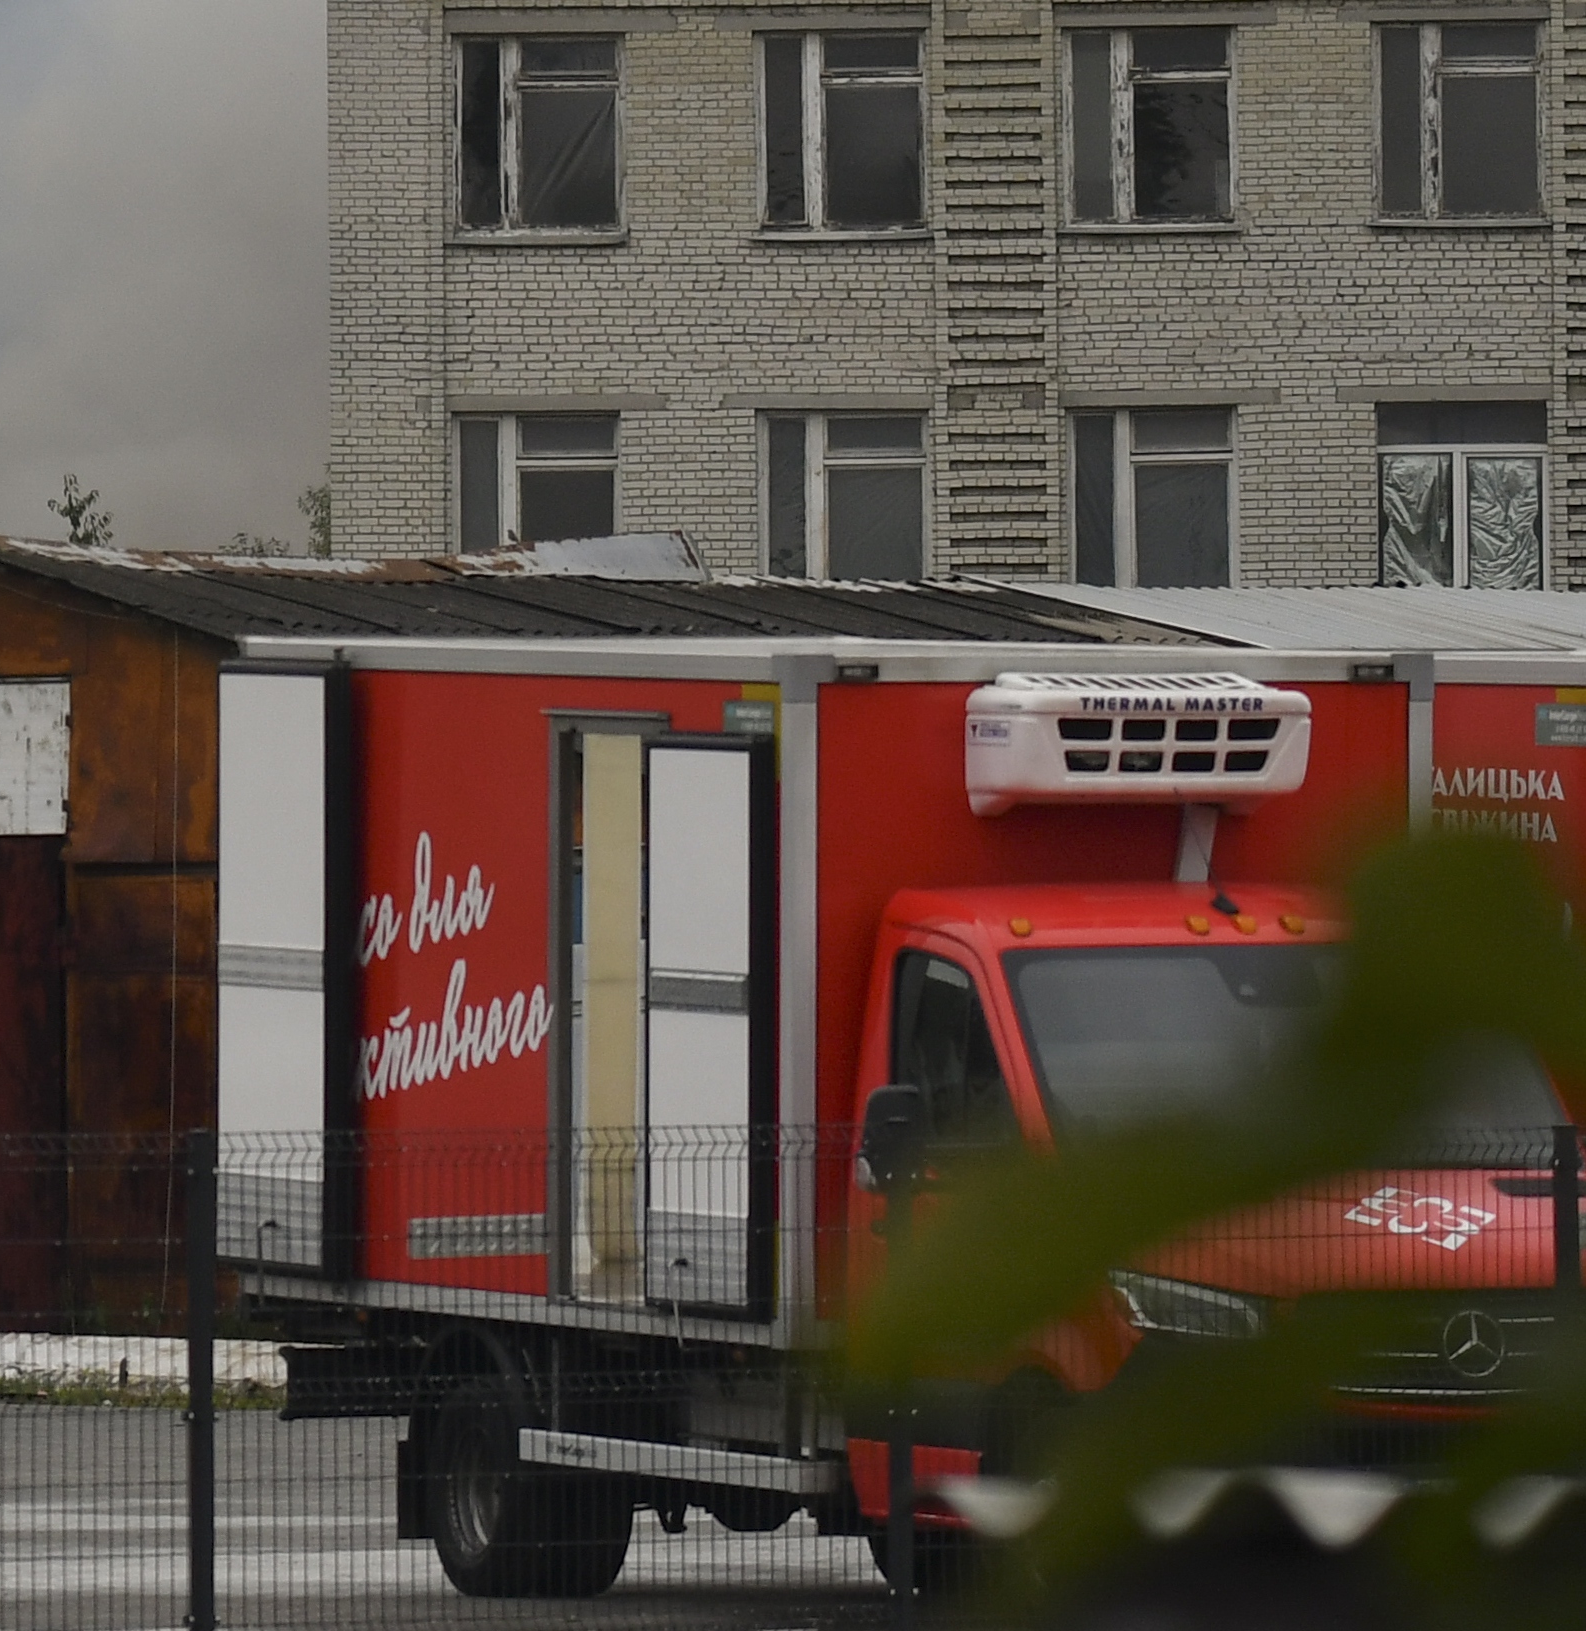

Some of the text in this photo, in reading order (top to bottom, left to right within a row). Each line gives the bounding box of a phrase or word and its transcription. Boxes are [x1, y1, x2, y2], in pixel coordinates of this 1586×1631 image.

[1080, 696, 1264, 712] THERMAL MASTER
[1432, 766, 1565, 804] АЛИЦЬКА
